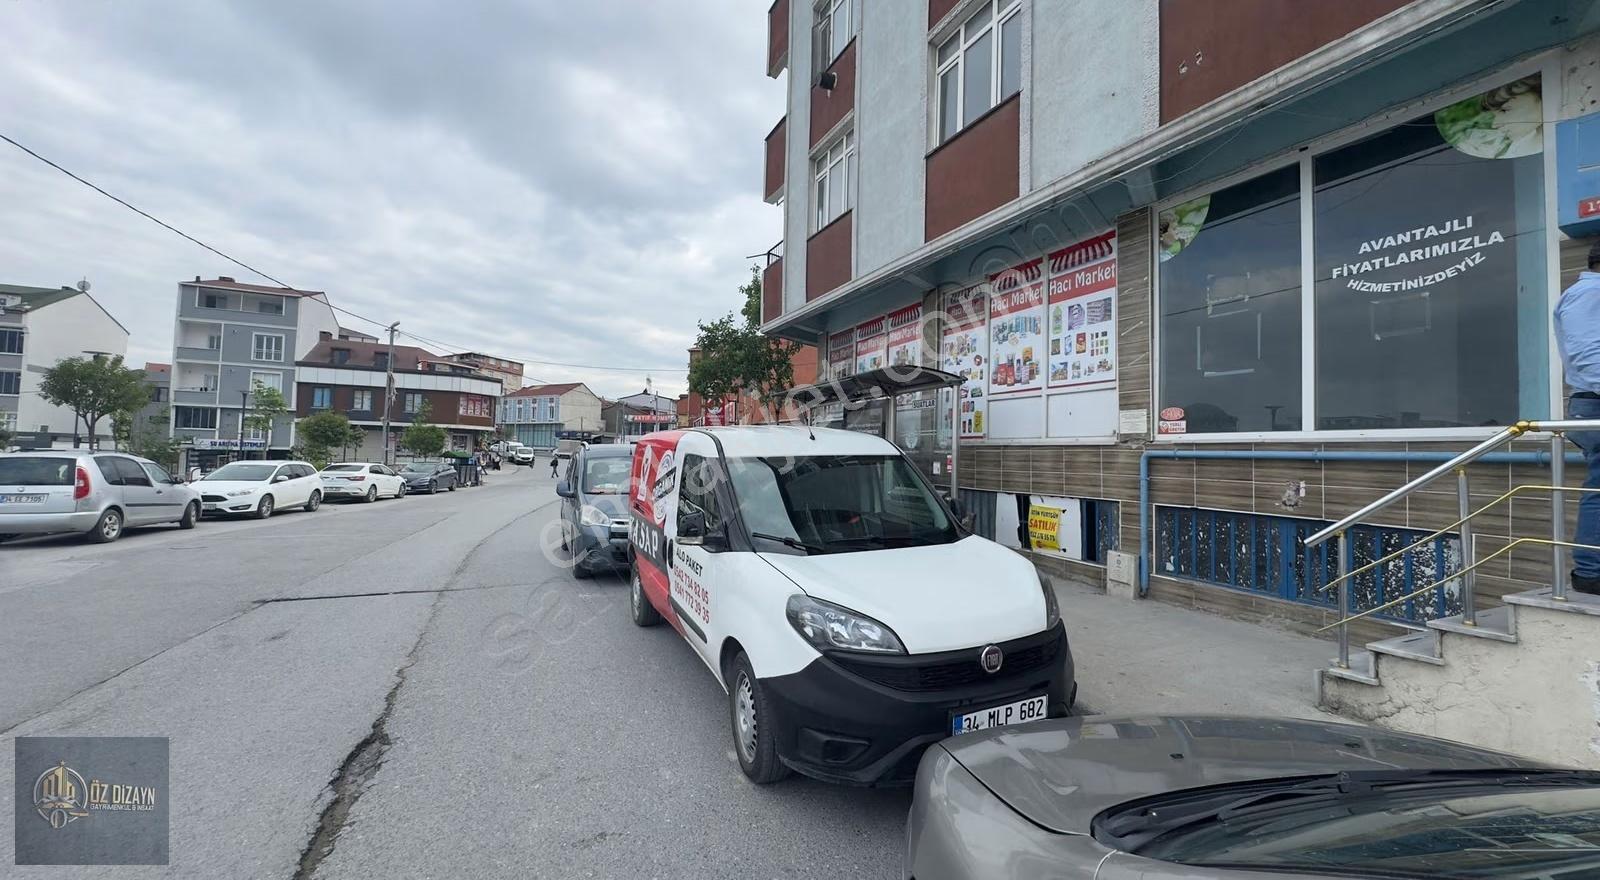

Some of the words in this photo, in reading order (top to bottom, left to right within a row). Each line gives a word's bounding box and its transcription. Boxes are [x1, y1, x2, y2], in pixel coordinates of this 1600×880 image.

[1358, 216, 1473, 254] AVANTAJLI
[1332, 231, 1504, 279] FİYATLARIMIZLA
[1049, 280, 1072, 296] Hacı
[1074, 263, 1116, 289] Market
[1347, 252, 1486, 292] HİZMETİNİZDEYİZ
[991, 297, 1009, 313] Hacı
[1011, 285, 1043, 307] Market
[1029, 518, 1057, 532] SATILIK
[676, 546, 686, 562] ALO
[686, 555, 703, 577] PAKET
[963, 715, 980, 732] 34
[988, 706, 1013, 728] MLP
[1020, 698, 1044, 721] 682
